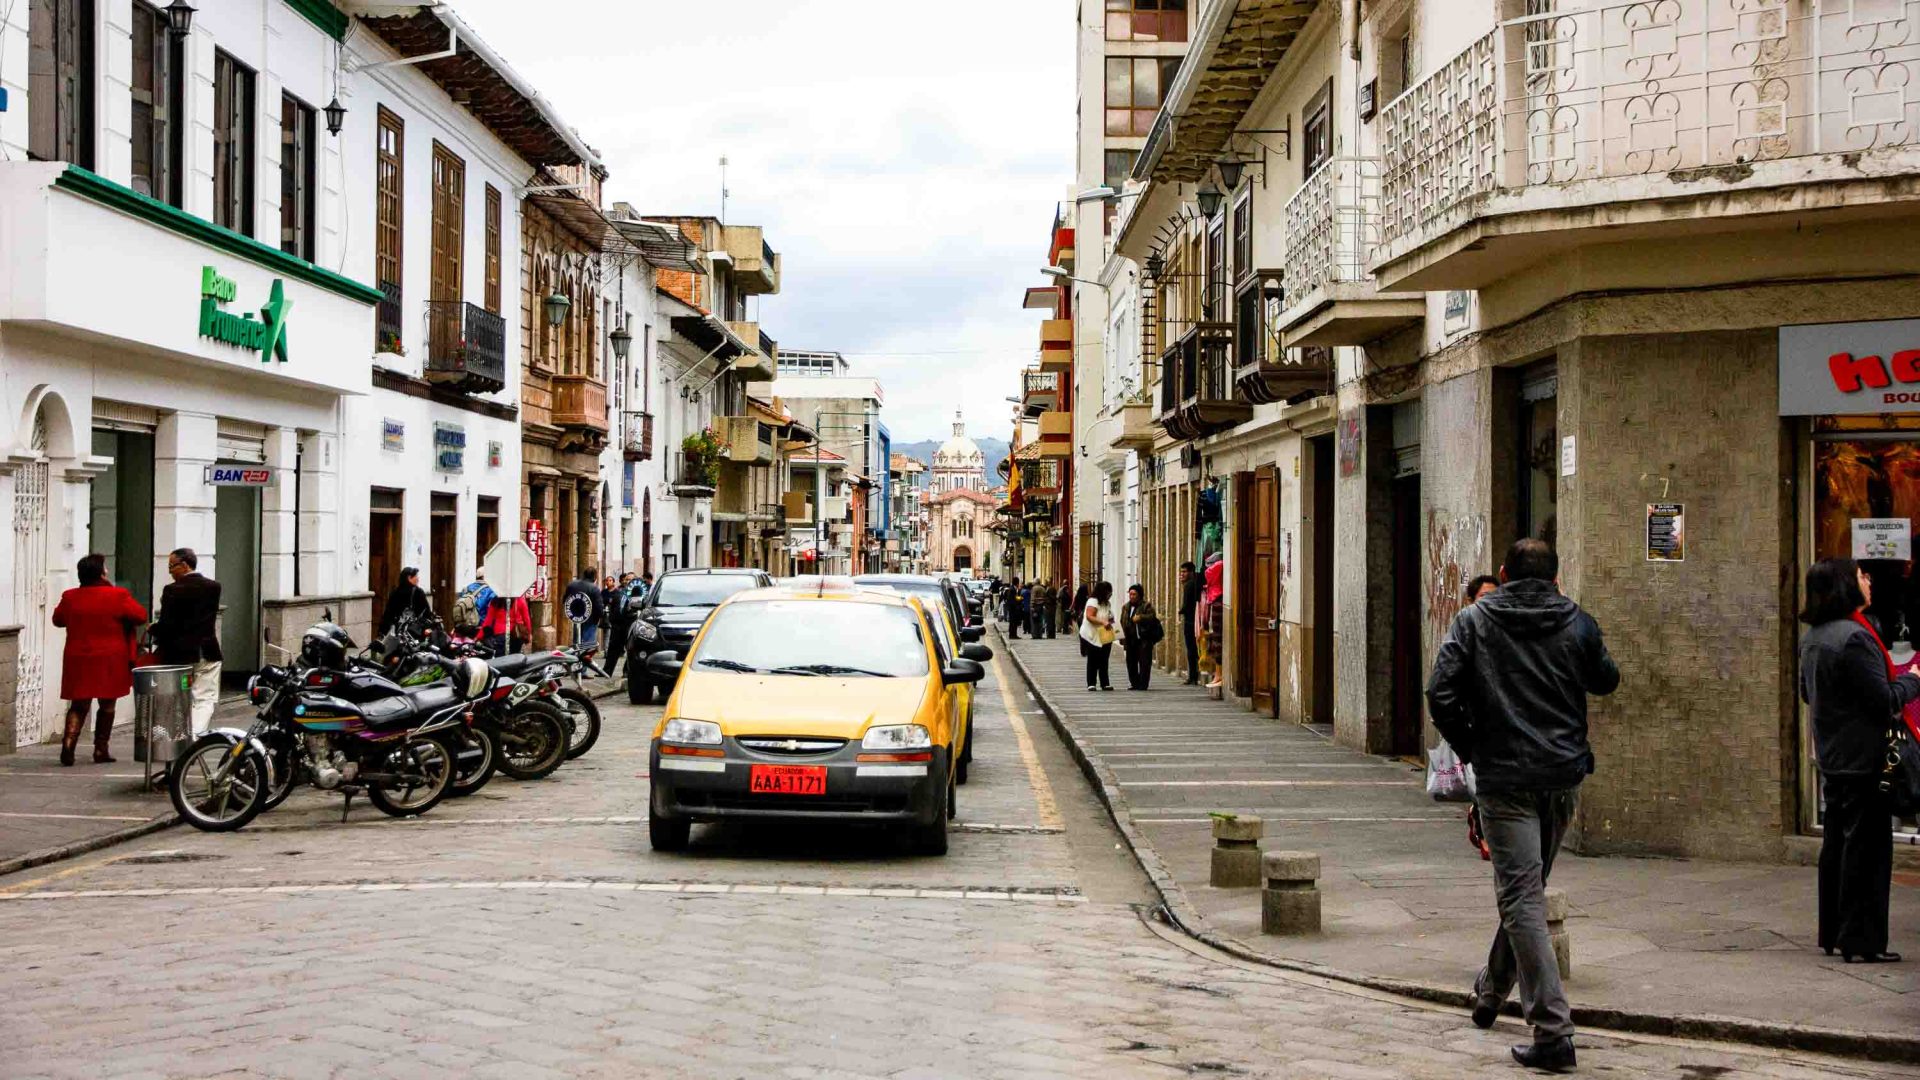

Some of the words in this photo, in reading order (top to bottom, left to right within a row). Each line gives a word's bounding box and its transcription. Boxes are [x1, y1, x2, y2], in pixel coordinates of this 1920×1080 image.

[201, 266, 236, 301] Banco
[213, 469, 270, 483] BANRED
[753, 774, 822, 793] AAA-1171
